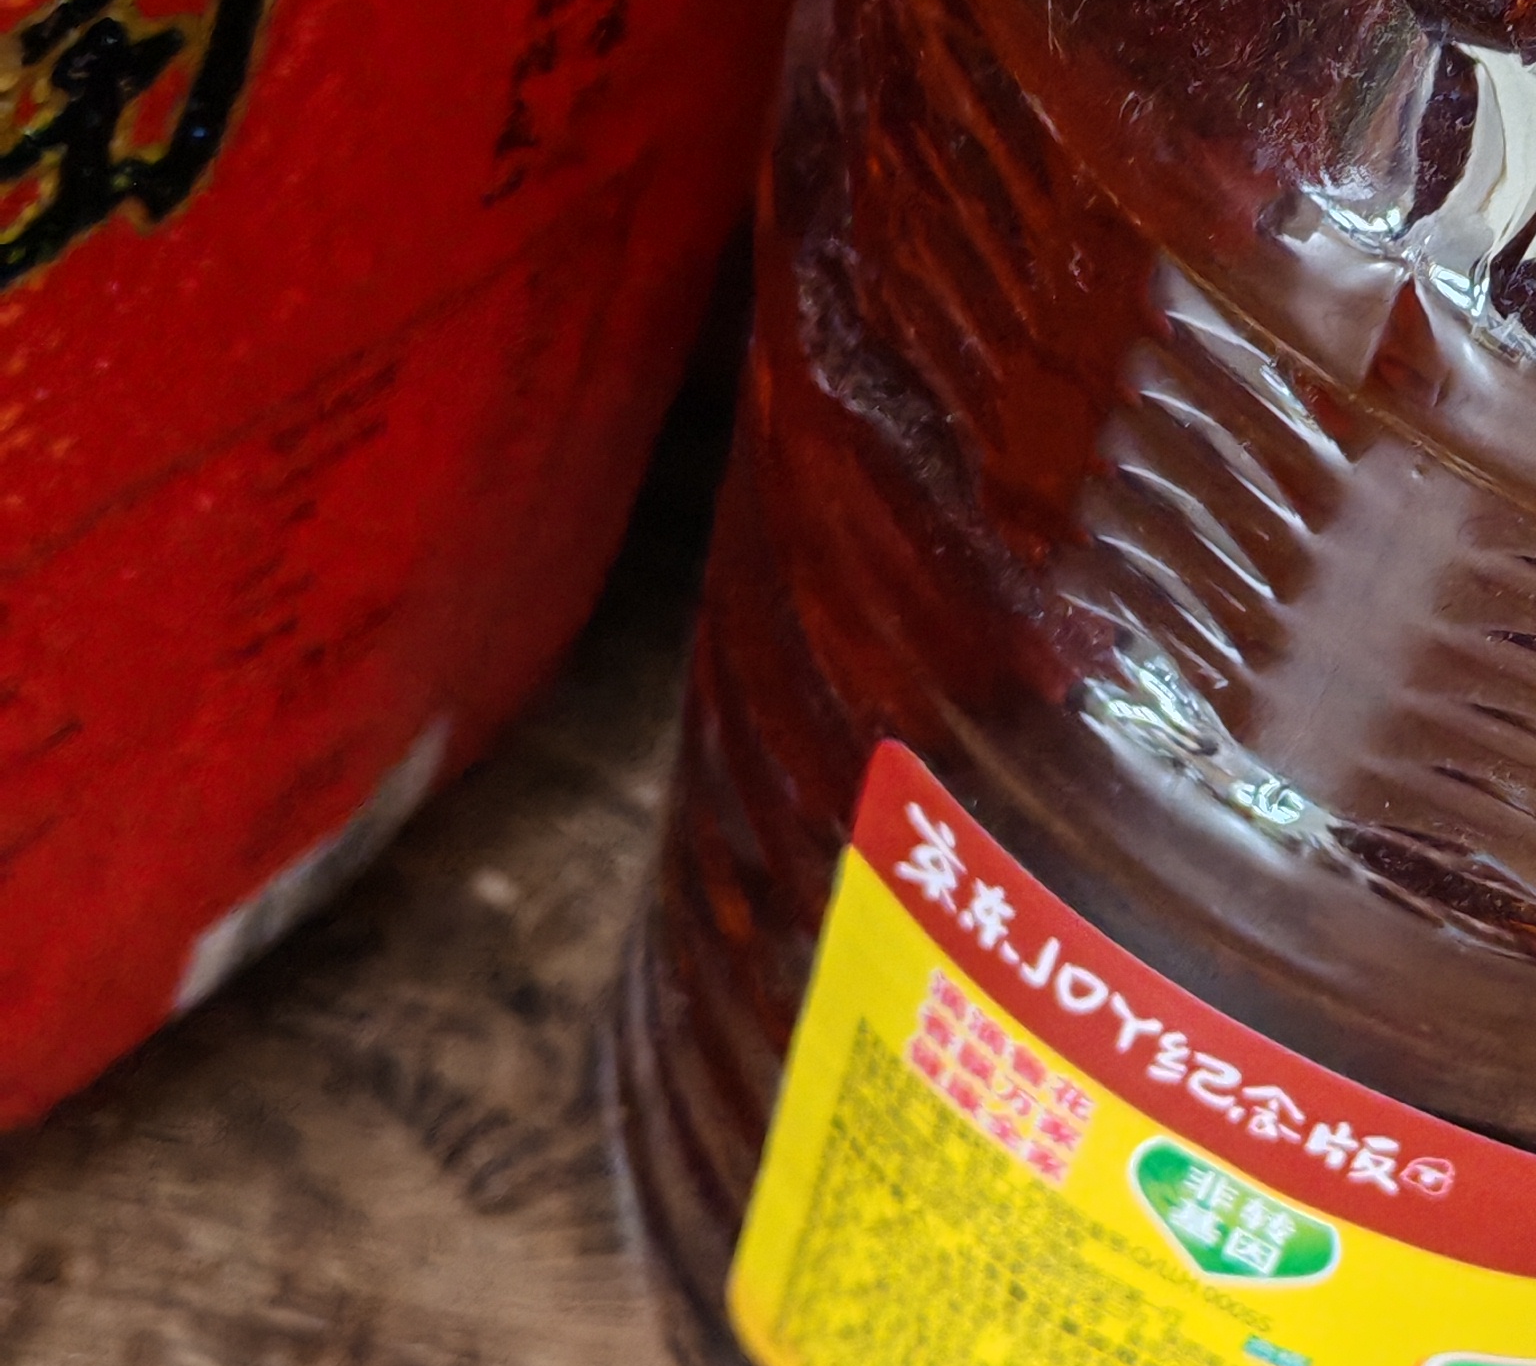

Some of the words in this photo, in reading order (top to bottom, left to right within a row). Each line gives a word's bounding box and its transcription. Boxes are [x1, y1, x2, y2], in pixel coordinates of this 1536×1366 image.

[895, 801, 1400, 1196] 京东JOY纪念版
